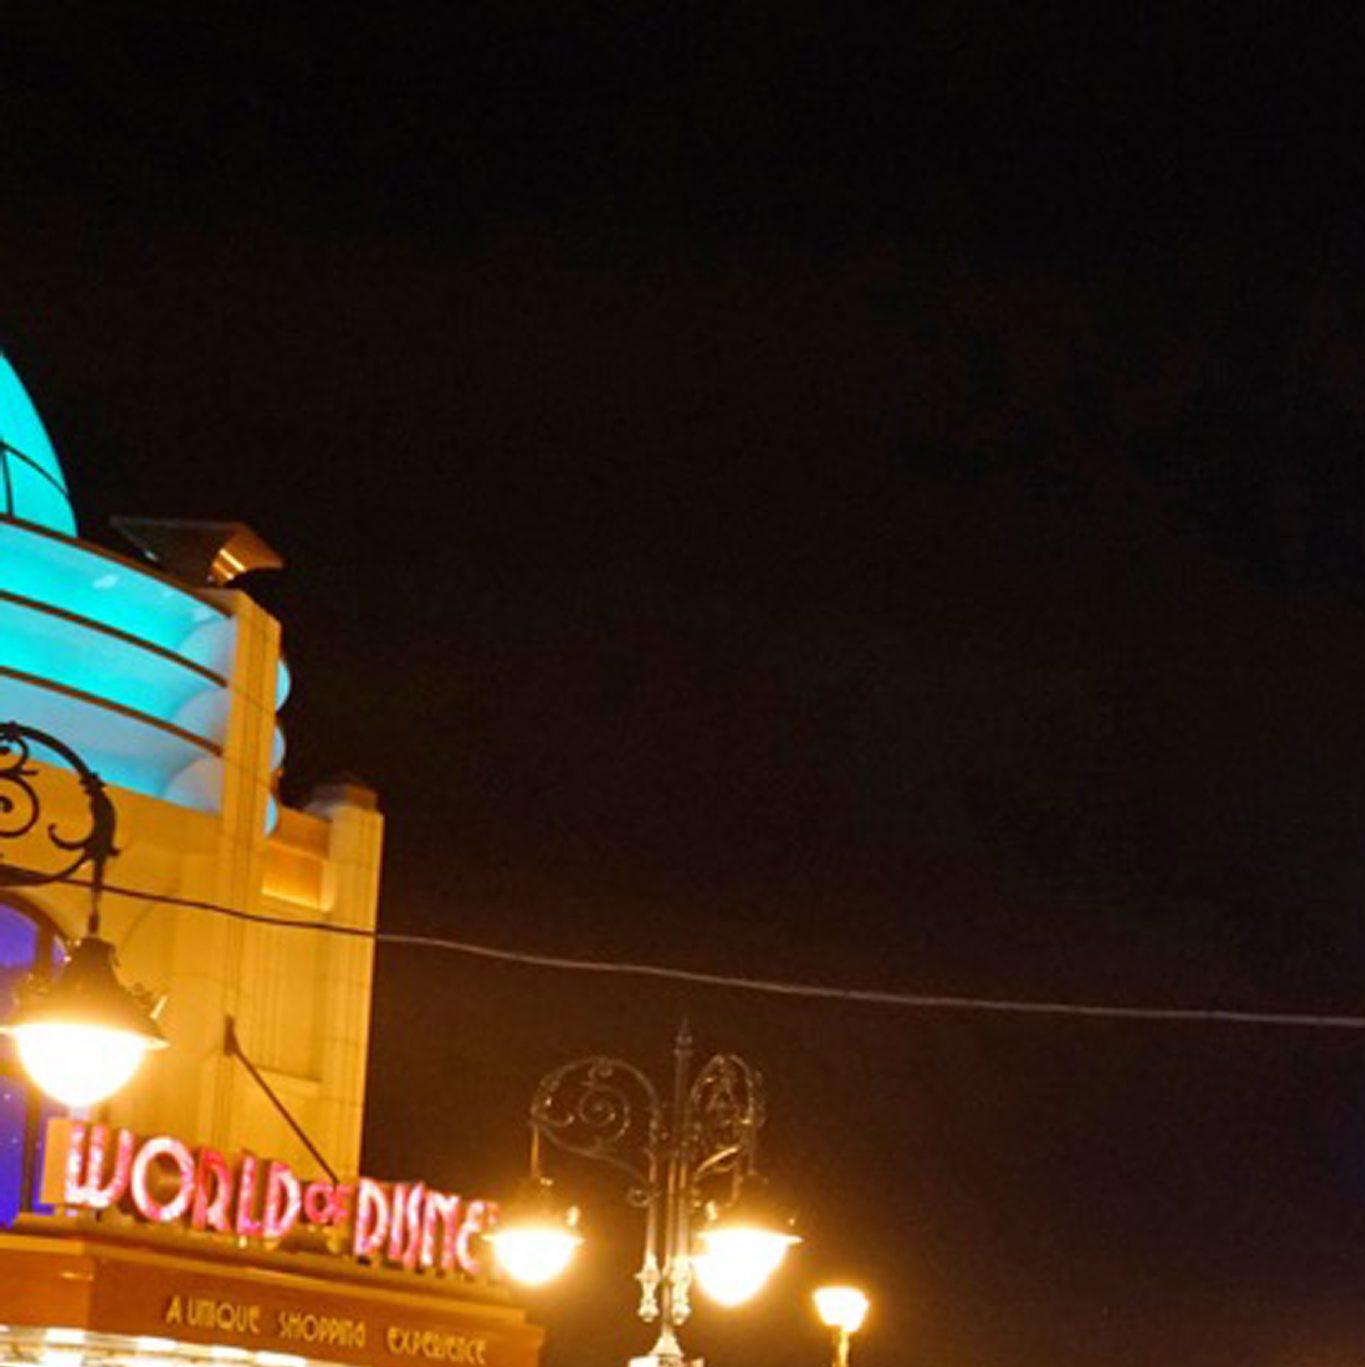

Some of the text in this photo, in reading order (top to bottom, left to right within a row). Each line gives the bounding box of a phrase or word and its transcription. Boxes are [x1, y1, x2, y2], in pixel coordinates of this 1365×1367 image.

[65, 1123, 300, 1238] WORLD
[166, 1295, 486, 1365] A UNIQUE SHOPPING EXPERIENCE
